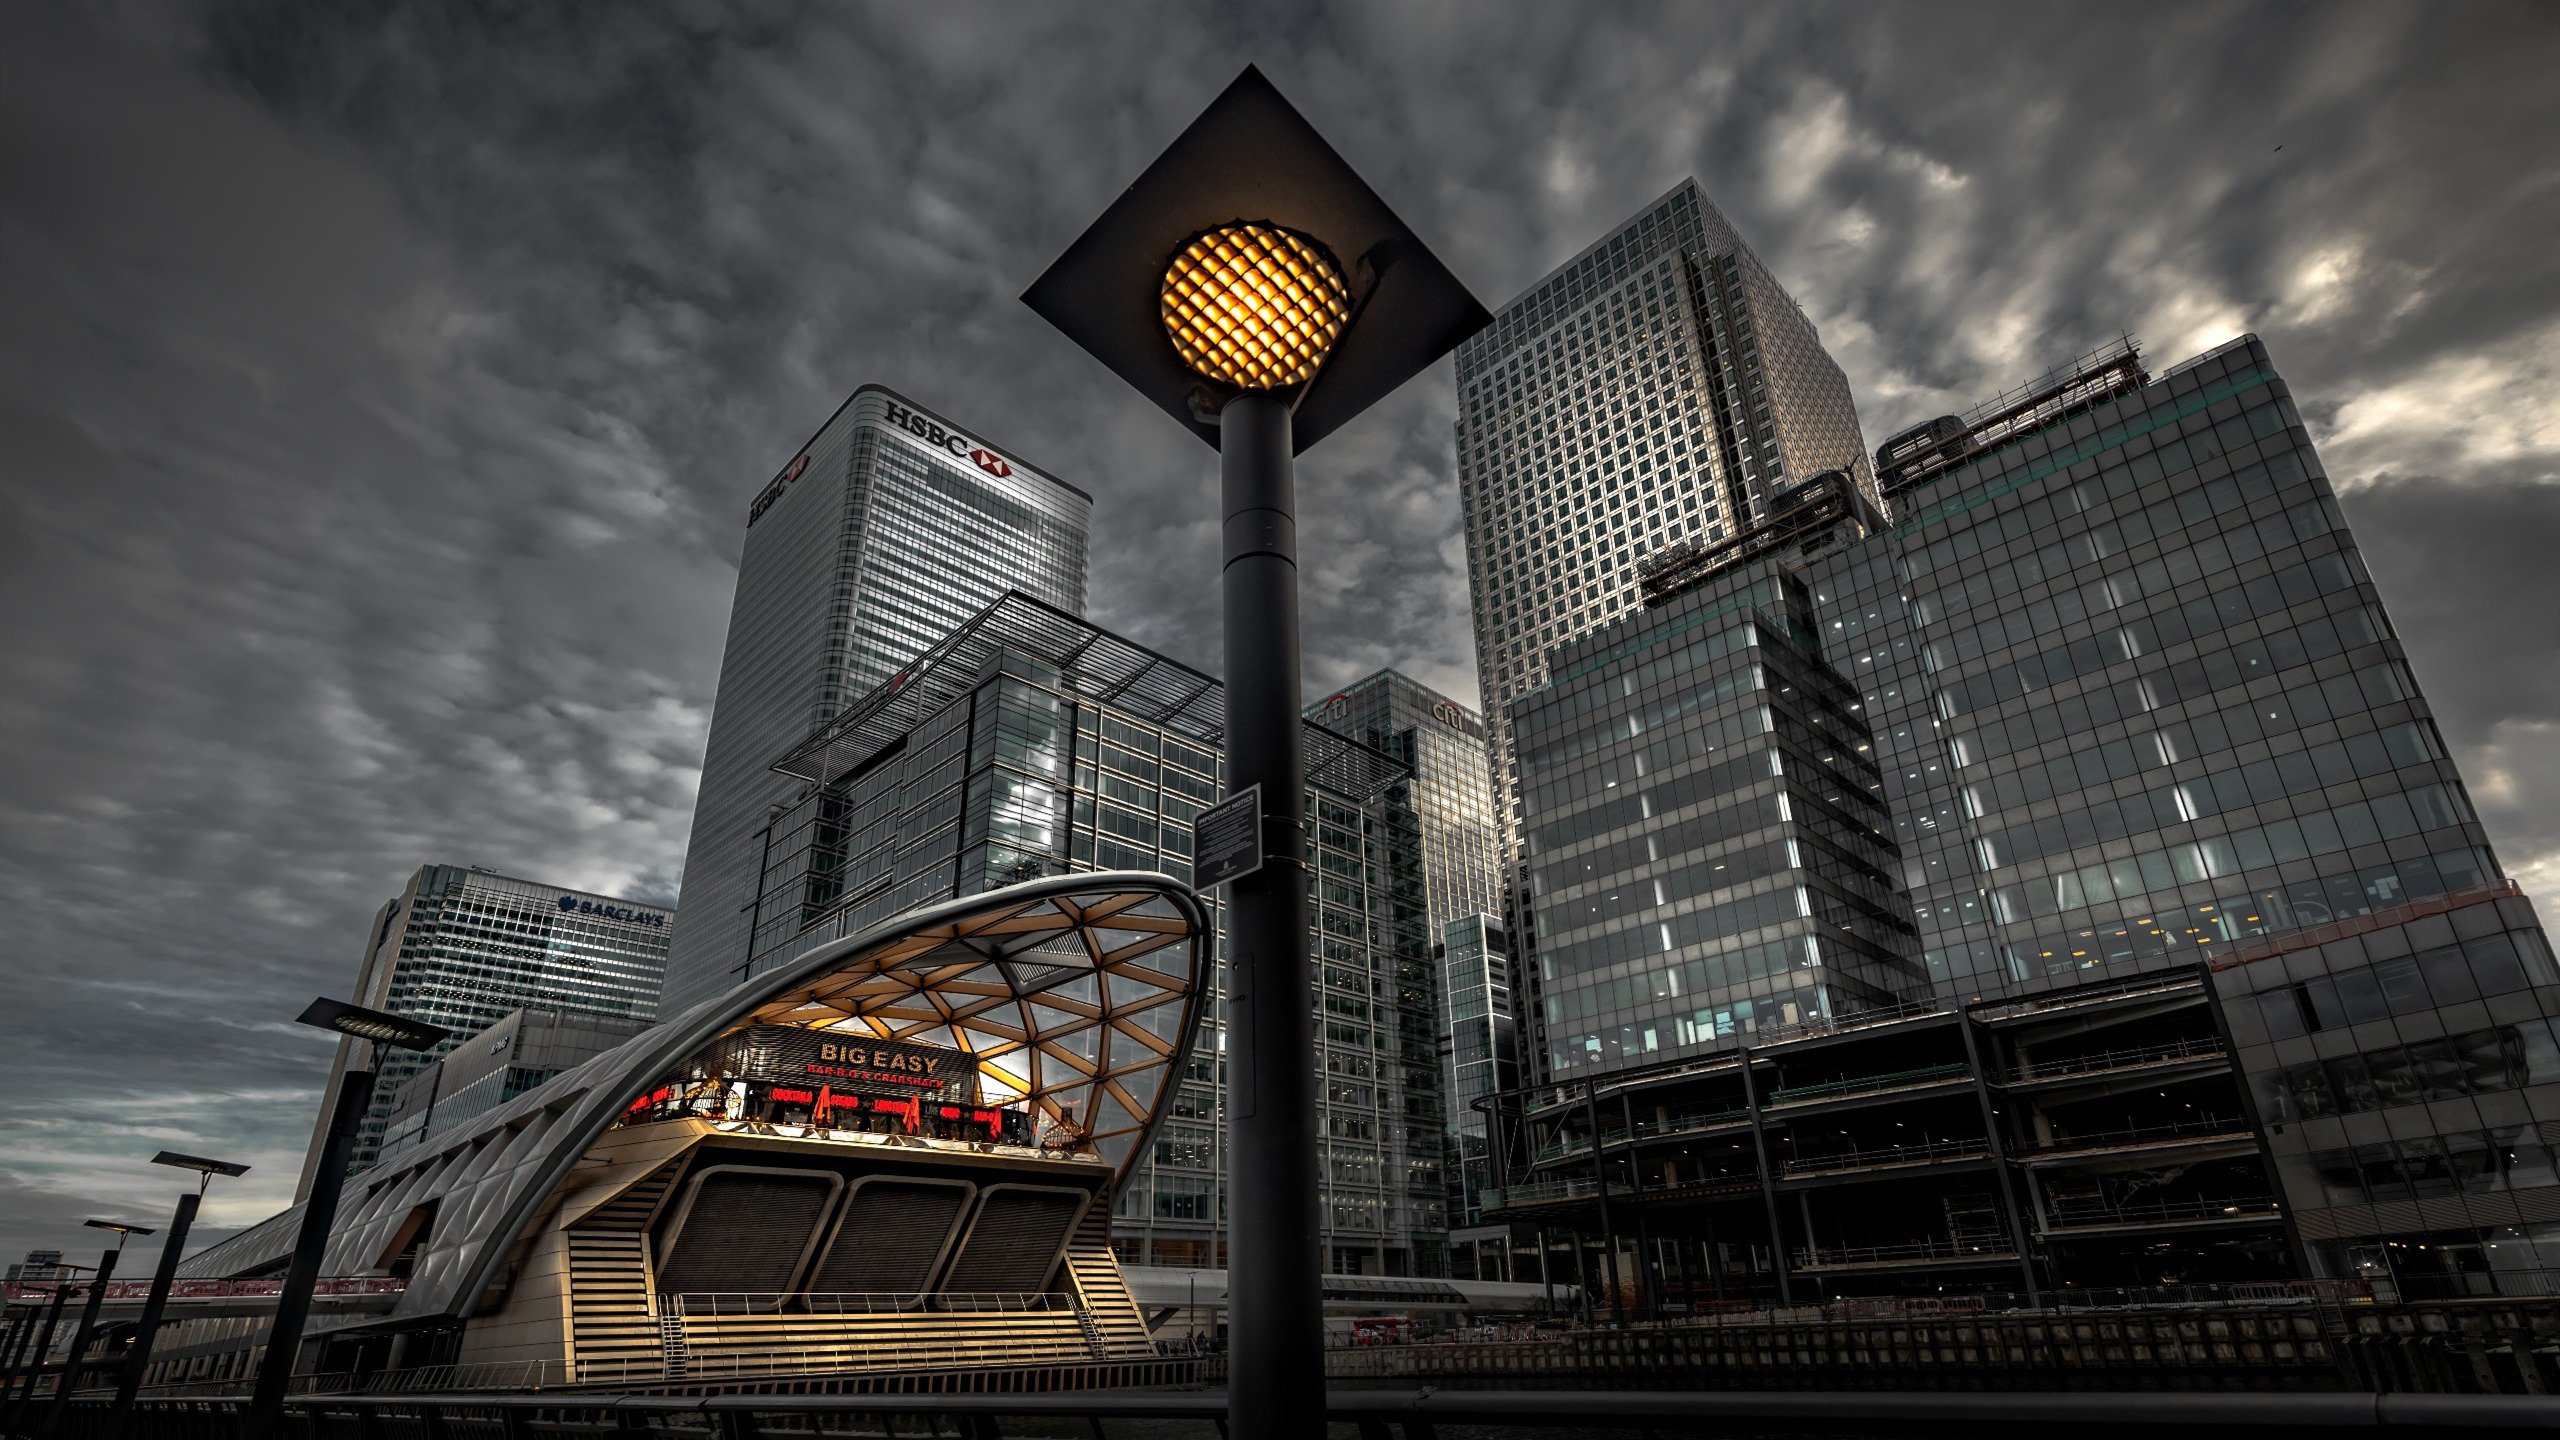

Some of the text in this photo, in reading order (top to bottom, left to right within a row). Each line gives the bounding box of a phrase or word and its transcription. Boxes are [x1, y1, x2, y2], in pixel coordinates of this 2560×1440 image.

[885, 400, 967, 457] HSBC
[1313, 694, 1348, 727] citi
[1432, 701, 1463, 731] citi
[1198, 794, 1254, 825] IMPORTANT NOTICE
[580, 900, 665, 927] BARCLAYS
[820, 1043, 940, 1074] BIG EASY
[873, 1072, 944, 1088] CRABSHACK
